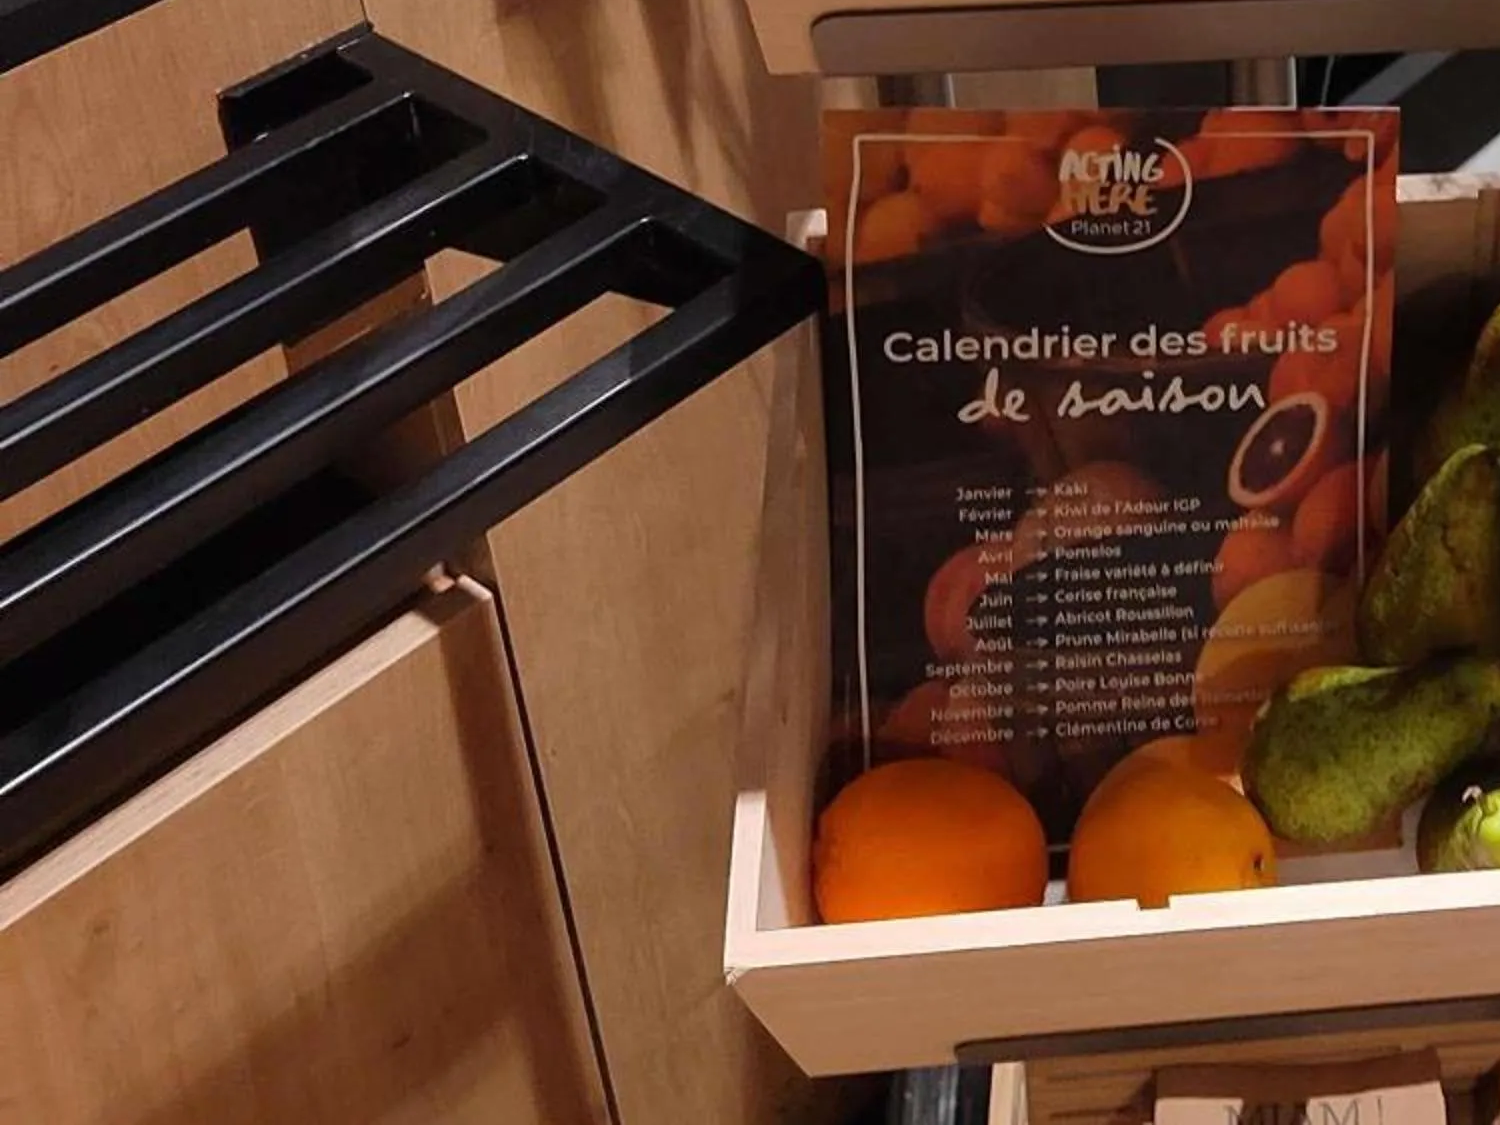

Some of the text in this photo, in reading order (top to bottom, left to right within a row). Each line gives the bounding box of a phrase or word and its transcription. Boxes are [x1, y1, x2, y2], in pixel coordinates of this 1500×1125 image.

[1058, 143, 1165, 183] ACTING
[1060, 182, 1159, 216] HERE
[1071, 219, 1151, 236] Planet 21
[883, 321, 1338, 363] Calendrier des fruits
[957, 368, 1267, 424] de saison
[956, 482, 1088, 502] Janvier Kaki
[959, 509, 1013, 523] Février
[1054, 503, 1088, 517] Kiwi
[1091, 502, 1111, 515] de
[1173, 498, 1200, 512] IGP
[975, 529, 1013, 543] Mars
[1054, 525, 1112, 540] Orange
[1116, 519, 1187, 537] sanguine
[1191, 520, 1210, 533] ou
[978, 546, 1121, 565] Avril Pomelos
[985, 571, 1013, 585] Mai
[1055, 566, 1101, 581] Fraise
[1105, 562, 1157, 580] variété
[979, 584, 1177, 608] Juin Cerise française
[965, 605, 1194, 630] Juillet Abricot Roussillon
[1055, 632, 1102, 647] Prune
[1106, 627, 1177, 645] Mirabelle
[925, 649, 1182, 678] Septembre Raisin Chasselas
[949, 681, 1014, 698] Octobre
[1055, 677, 1096, 692] Poire
[1100, 672, 1151, 690] Louise
[930, 704, 1014, 723] Novembre
[1055, 698, 1117, 715] Pomme
[1122, 693, 1166, 710] Reine
[930, 728, 1014, 746] Décembre
[1055, 718, 1147, 737] Clémentine
[1151, 716, 1171, 732] de
[1223, 1098, 1361, 1125] MIAM
